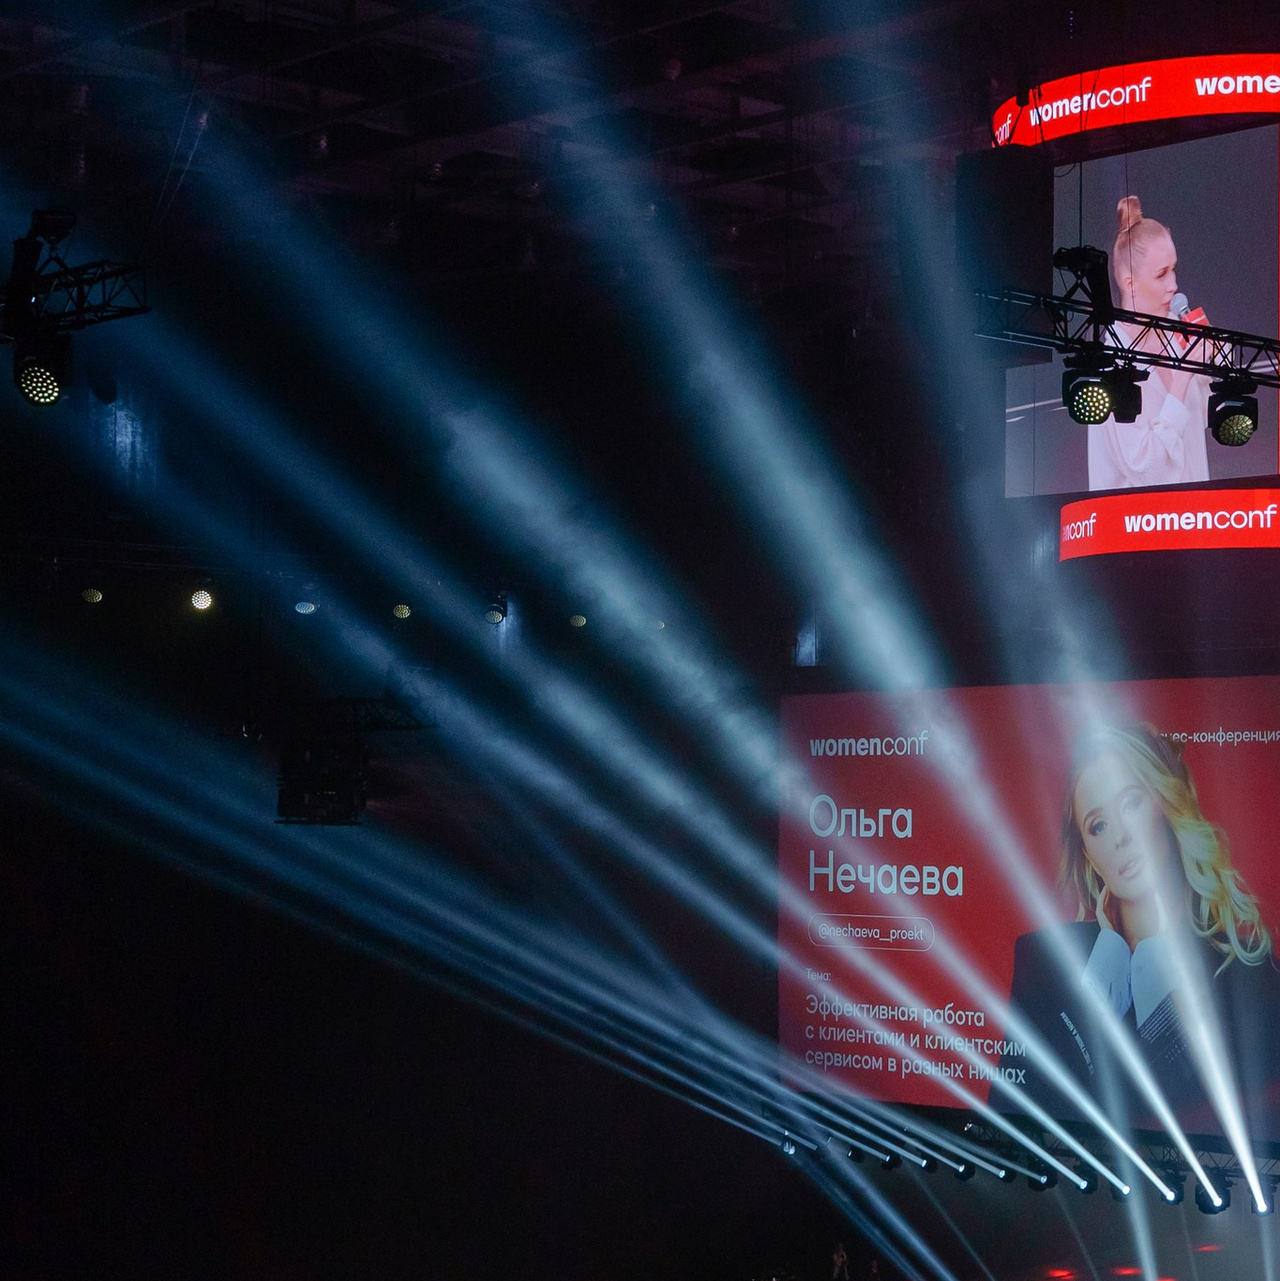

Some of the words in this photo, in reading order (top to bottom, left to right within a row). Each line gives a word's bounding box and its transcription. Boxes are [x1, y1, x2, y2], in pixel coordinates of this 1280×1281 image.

[1029, 76, 1152, 127] womenconf
[1124, 503, 1278, 533] womenconf
[809, 729, 929, 757] womenconf
[808, 794, 913, 839] Ольга
[809, 849, 964, 897] Нечаева
[805, 968, 832, 982] Тема:
[805, 994, 918, 1022] Эффективная
[923, 1003, 985, 1029] работа
[805, 1026, 815, 1039] с
[819, 1027, 905, 1047] клиентами
[910, 1033, 920, 1048] и
[925, 1034, 1026, 1057] клиентским
[805, 1049, 883, 1072] сервисом
[888, 1058, 897, 1071] в
[901, 1058, 964, 1079] разных
[968, 1064, 1026, 1085] нишах
